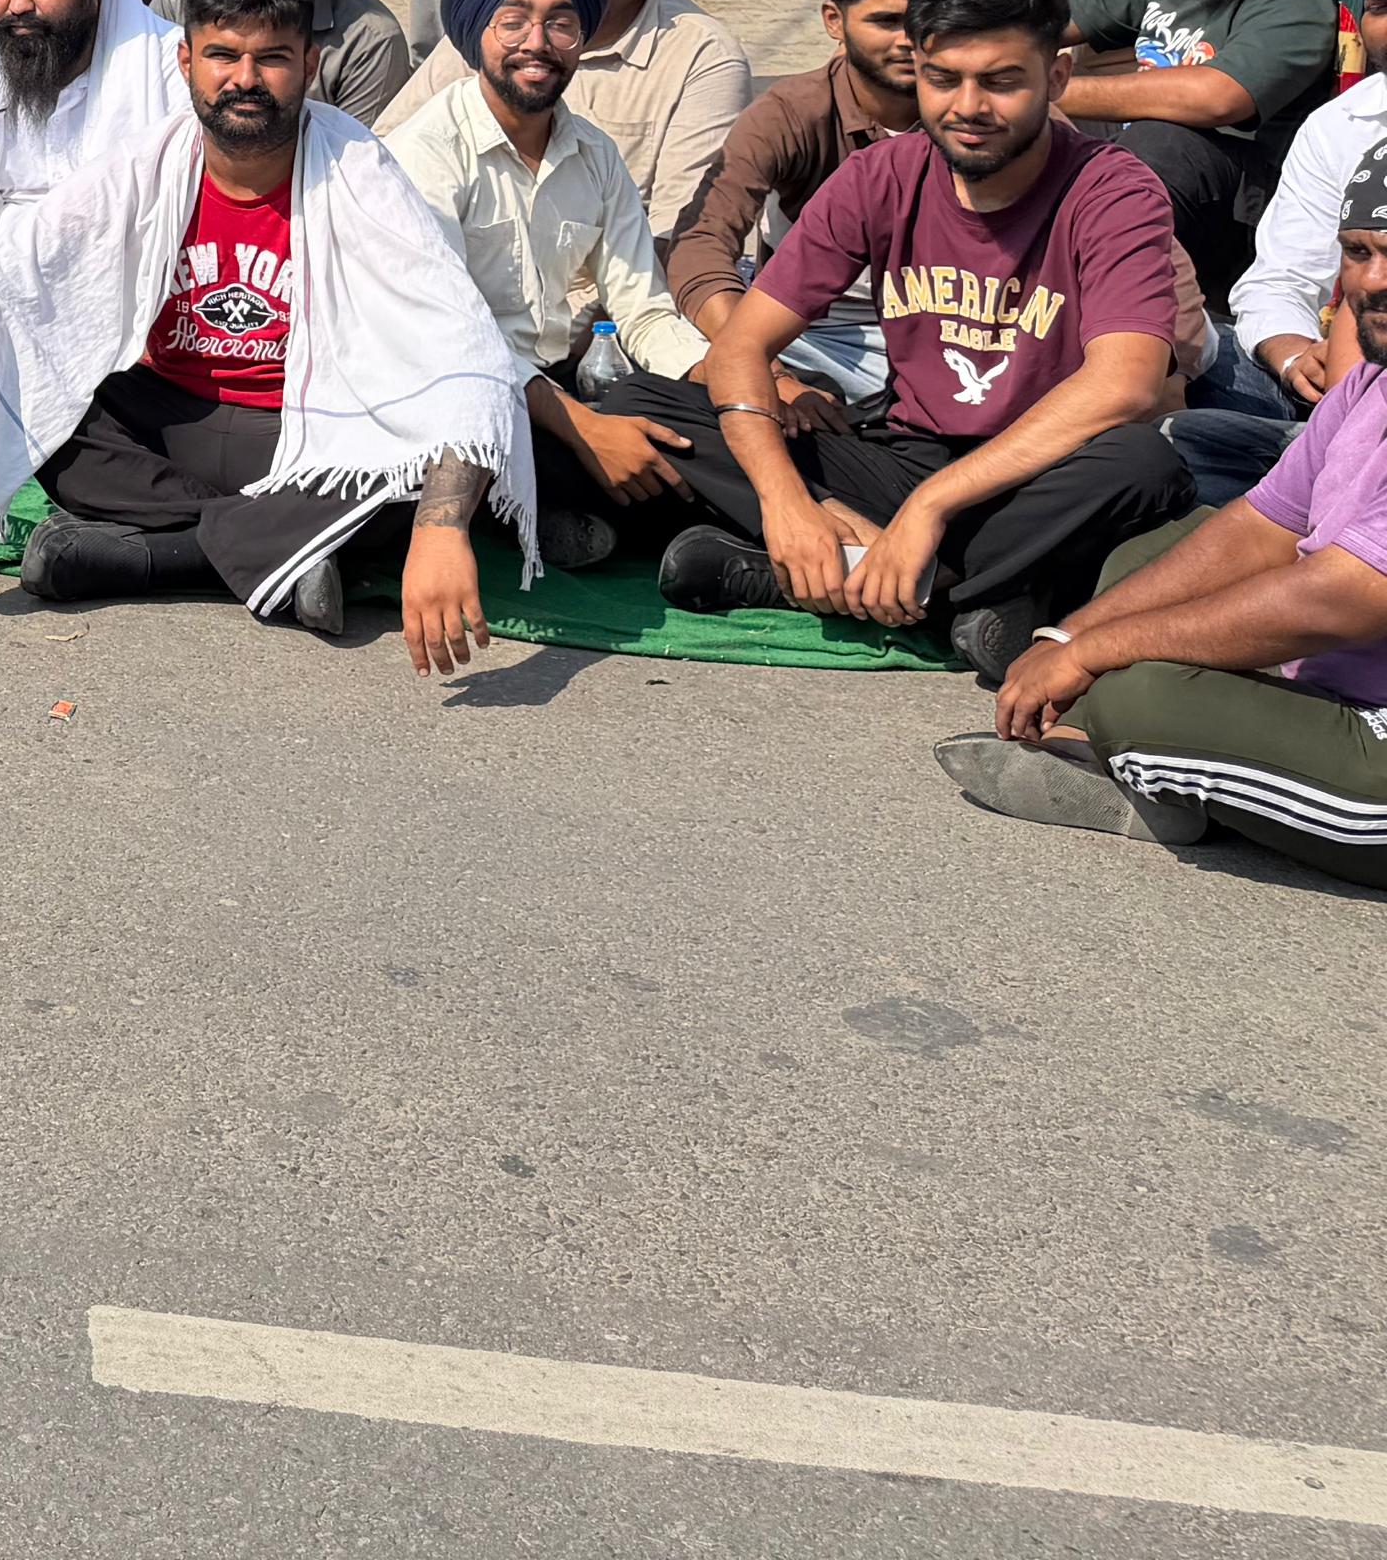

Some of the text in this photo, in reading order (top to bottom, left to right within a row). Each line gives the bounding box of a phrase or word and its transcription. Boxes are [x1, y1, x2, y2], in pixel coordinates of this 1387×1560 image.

[235, 243, 294, 303] YOR
[208, 293, 227, 305] RICH
[940, 320, 1017, 351] EAGLE
